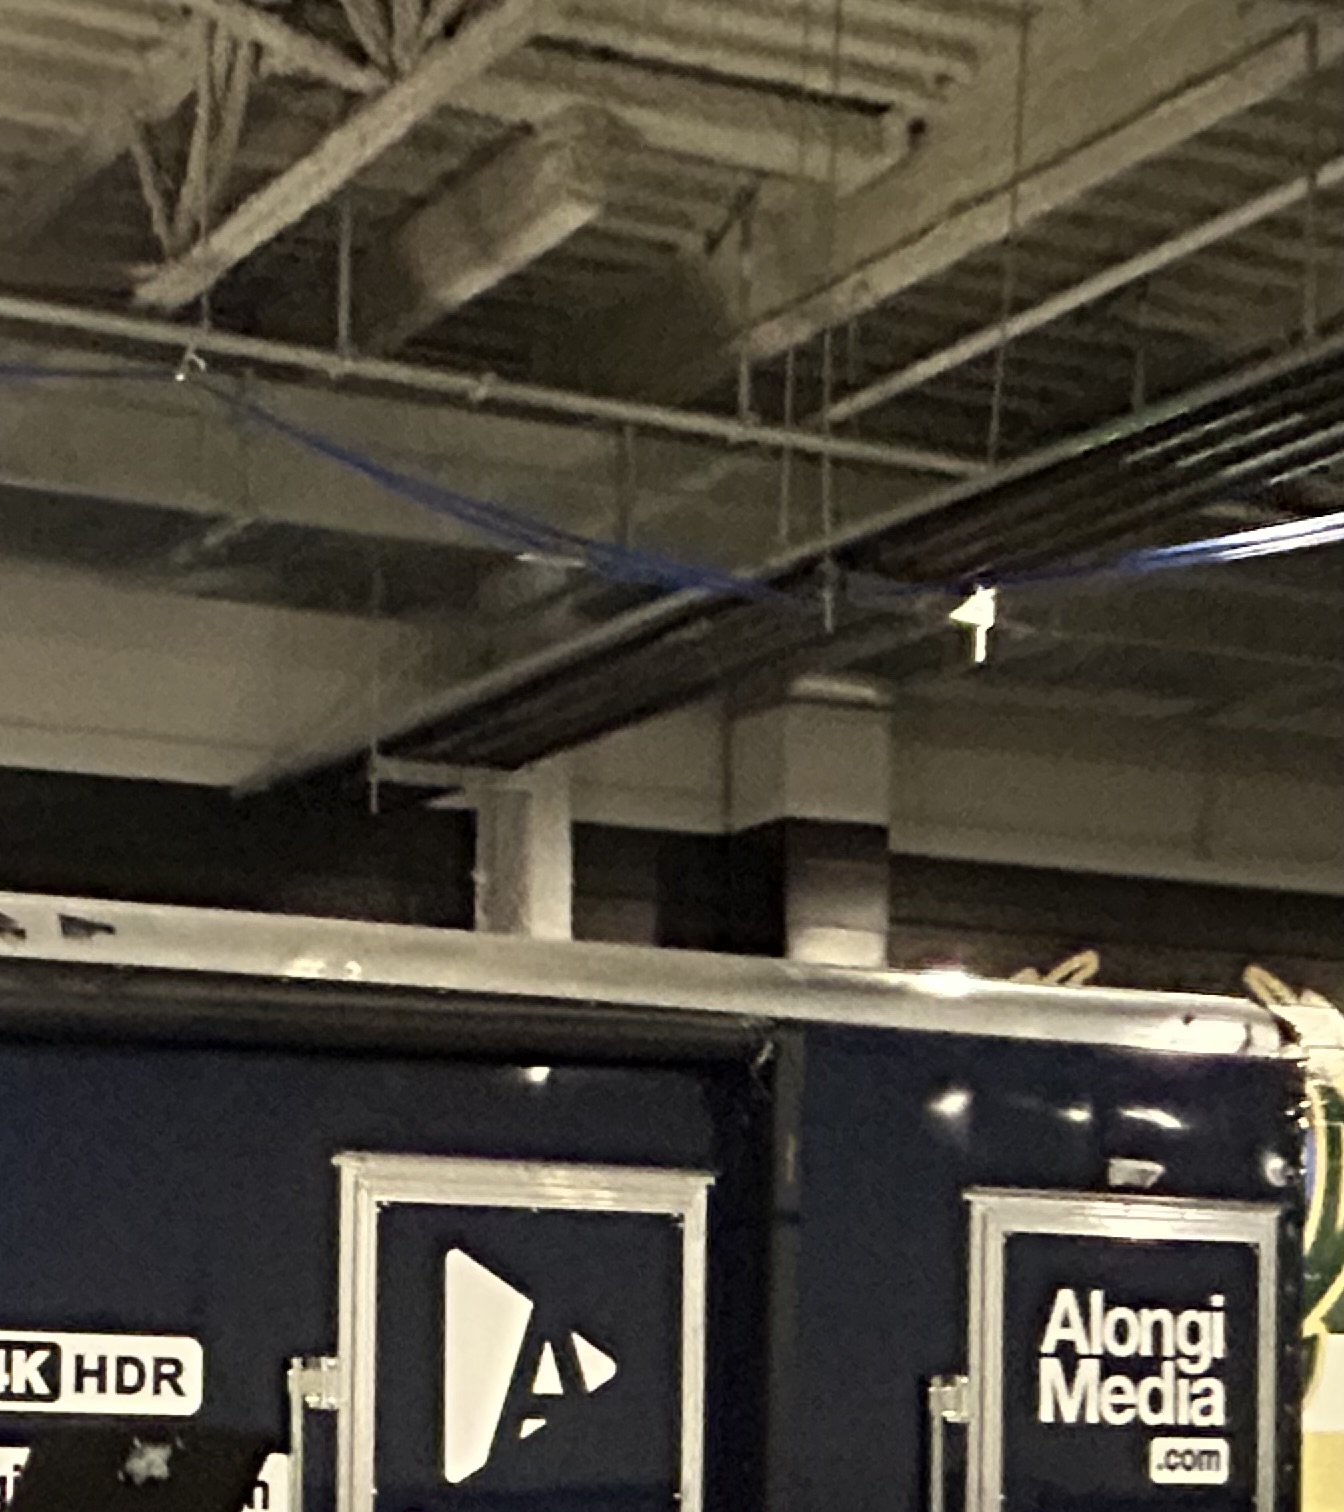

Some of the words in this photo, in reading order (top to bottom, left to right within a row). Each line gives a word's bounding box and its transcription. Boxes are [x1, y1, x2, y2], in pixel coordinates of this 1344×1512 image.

[1039, 1288, 1226, 1375] Alongi
[73, 1354, 186, 1396] HDR
[1038, 1356, 1226, 1426] Media
[1156, 1447, 1221, 1472] .com
